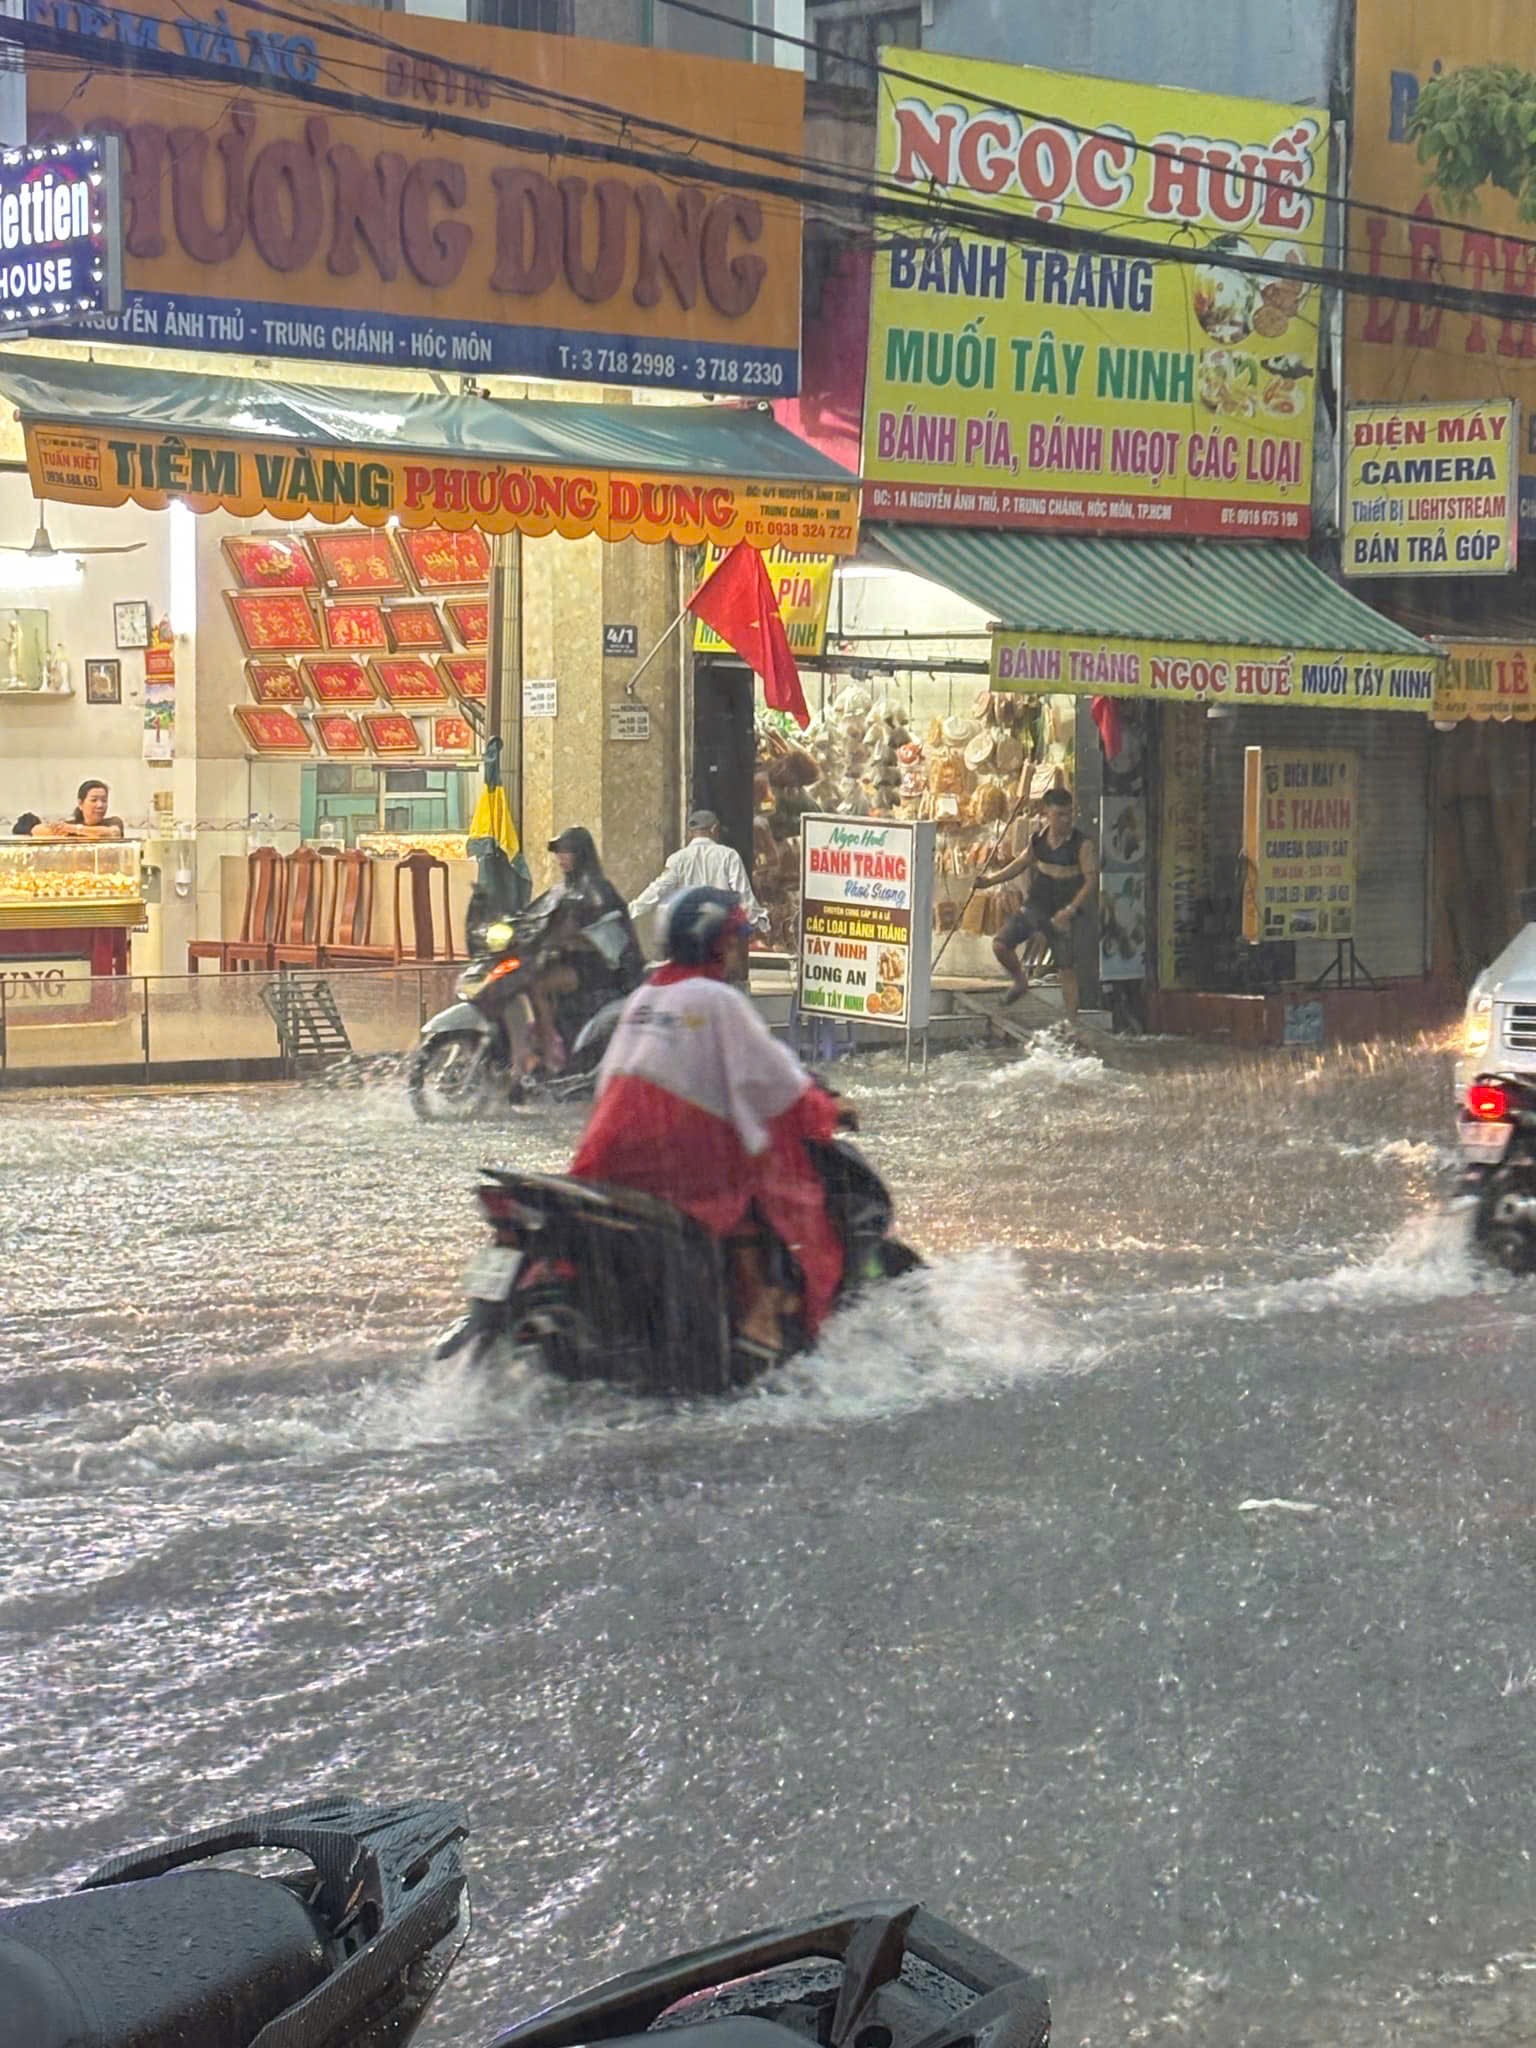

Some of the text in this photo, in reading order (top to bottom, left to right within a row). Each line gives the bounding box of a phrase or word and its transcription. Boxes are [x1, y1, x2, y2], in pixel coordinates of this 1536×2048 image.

[894, 103, 1314, 231] NGỌC HUẾ
[0, 174, 89, 250] ettien
[28, 100, 767, 319] HƯƠNG DUNG
[1361, 193, 1442, 348] LÊ
[164, 302, 204, 338] ẢNH
[207, 308, 244, 342] THỦ
[263, 320, 325, 349] TRUNG
[332, 323, 394, 354] CHÁNH
[411, 328, 446, 358] HÓC
[452, 331, 492, 361] MÔN
[598, 350, 628, 373] 718
[632, 352, 675, 377] 2998
[710, 359, 738, 382] 718
[743, 362, 783, 386] 2330
[884, 316, 1194, 402] MUỐI TÂY NINH
[877, 404, 1303, 494] BÁNH PÍA, BÁNH NGỌT CÁC LOẠI
[1354, 415, 1426, 450] ĐIỆN
[1437, 412, 1507, 443] MÁY
[255, 447, 391, 508] VÀNG
[403, 466, 597, 519] PHƯƠNG
[609, 481, 736, 529] DUNG
[1361, 456, 1496, 485] CAMERA
[1013, 497, 1046, 515] TRUNG
[1407, 496, 1506, 520] LIGHTSTREAM
[802, 523, 825, 538] 324
[1354, 528, 1500, 563] BÁN TRẢ GÓP
[606, 628, 634, 644] 4/1
[999, 641, 1433, 700] BÁNH TRÁNG NGỌC HUẾ MUỐI TÂY NINH
[1497, 650, 1529, 695] LÊ
[807, 916, 825, 932] CÁC
[807, 937, 867, 960] TÂY NINH
[805, 964, 866, 986] LONG AN
